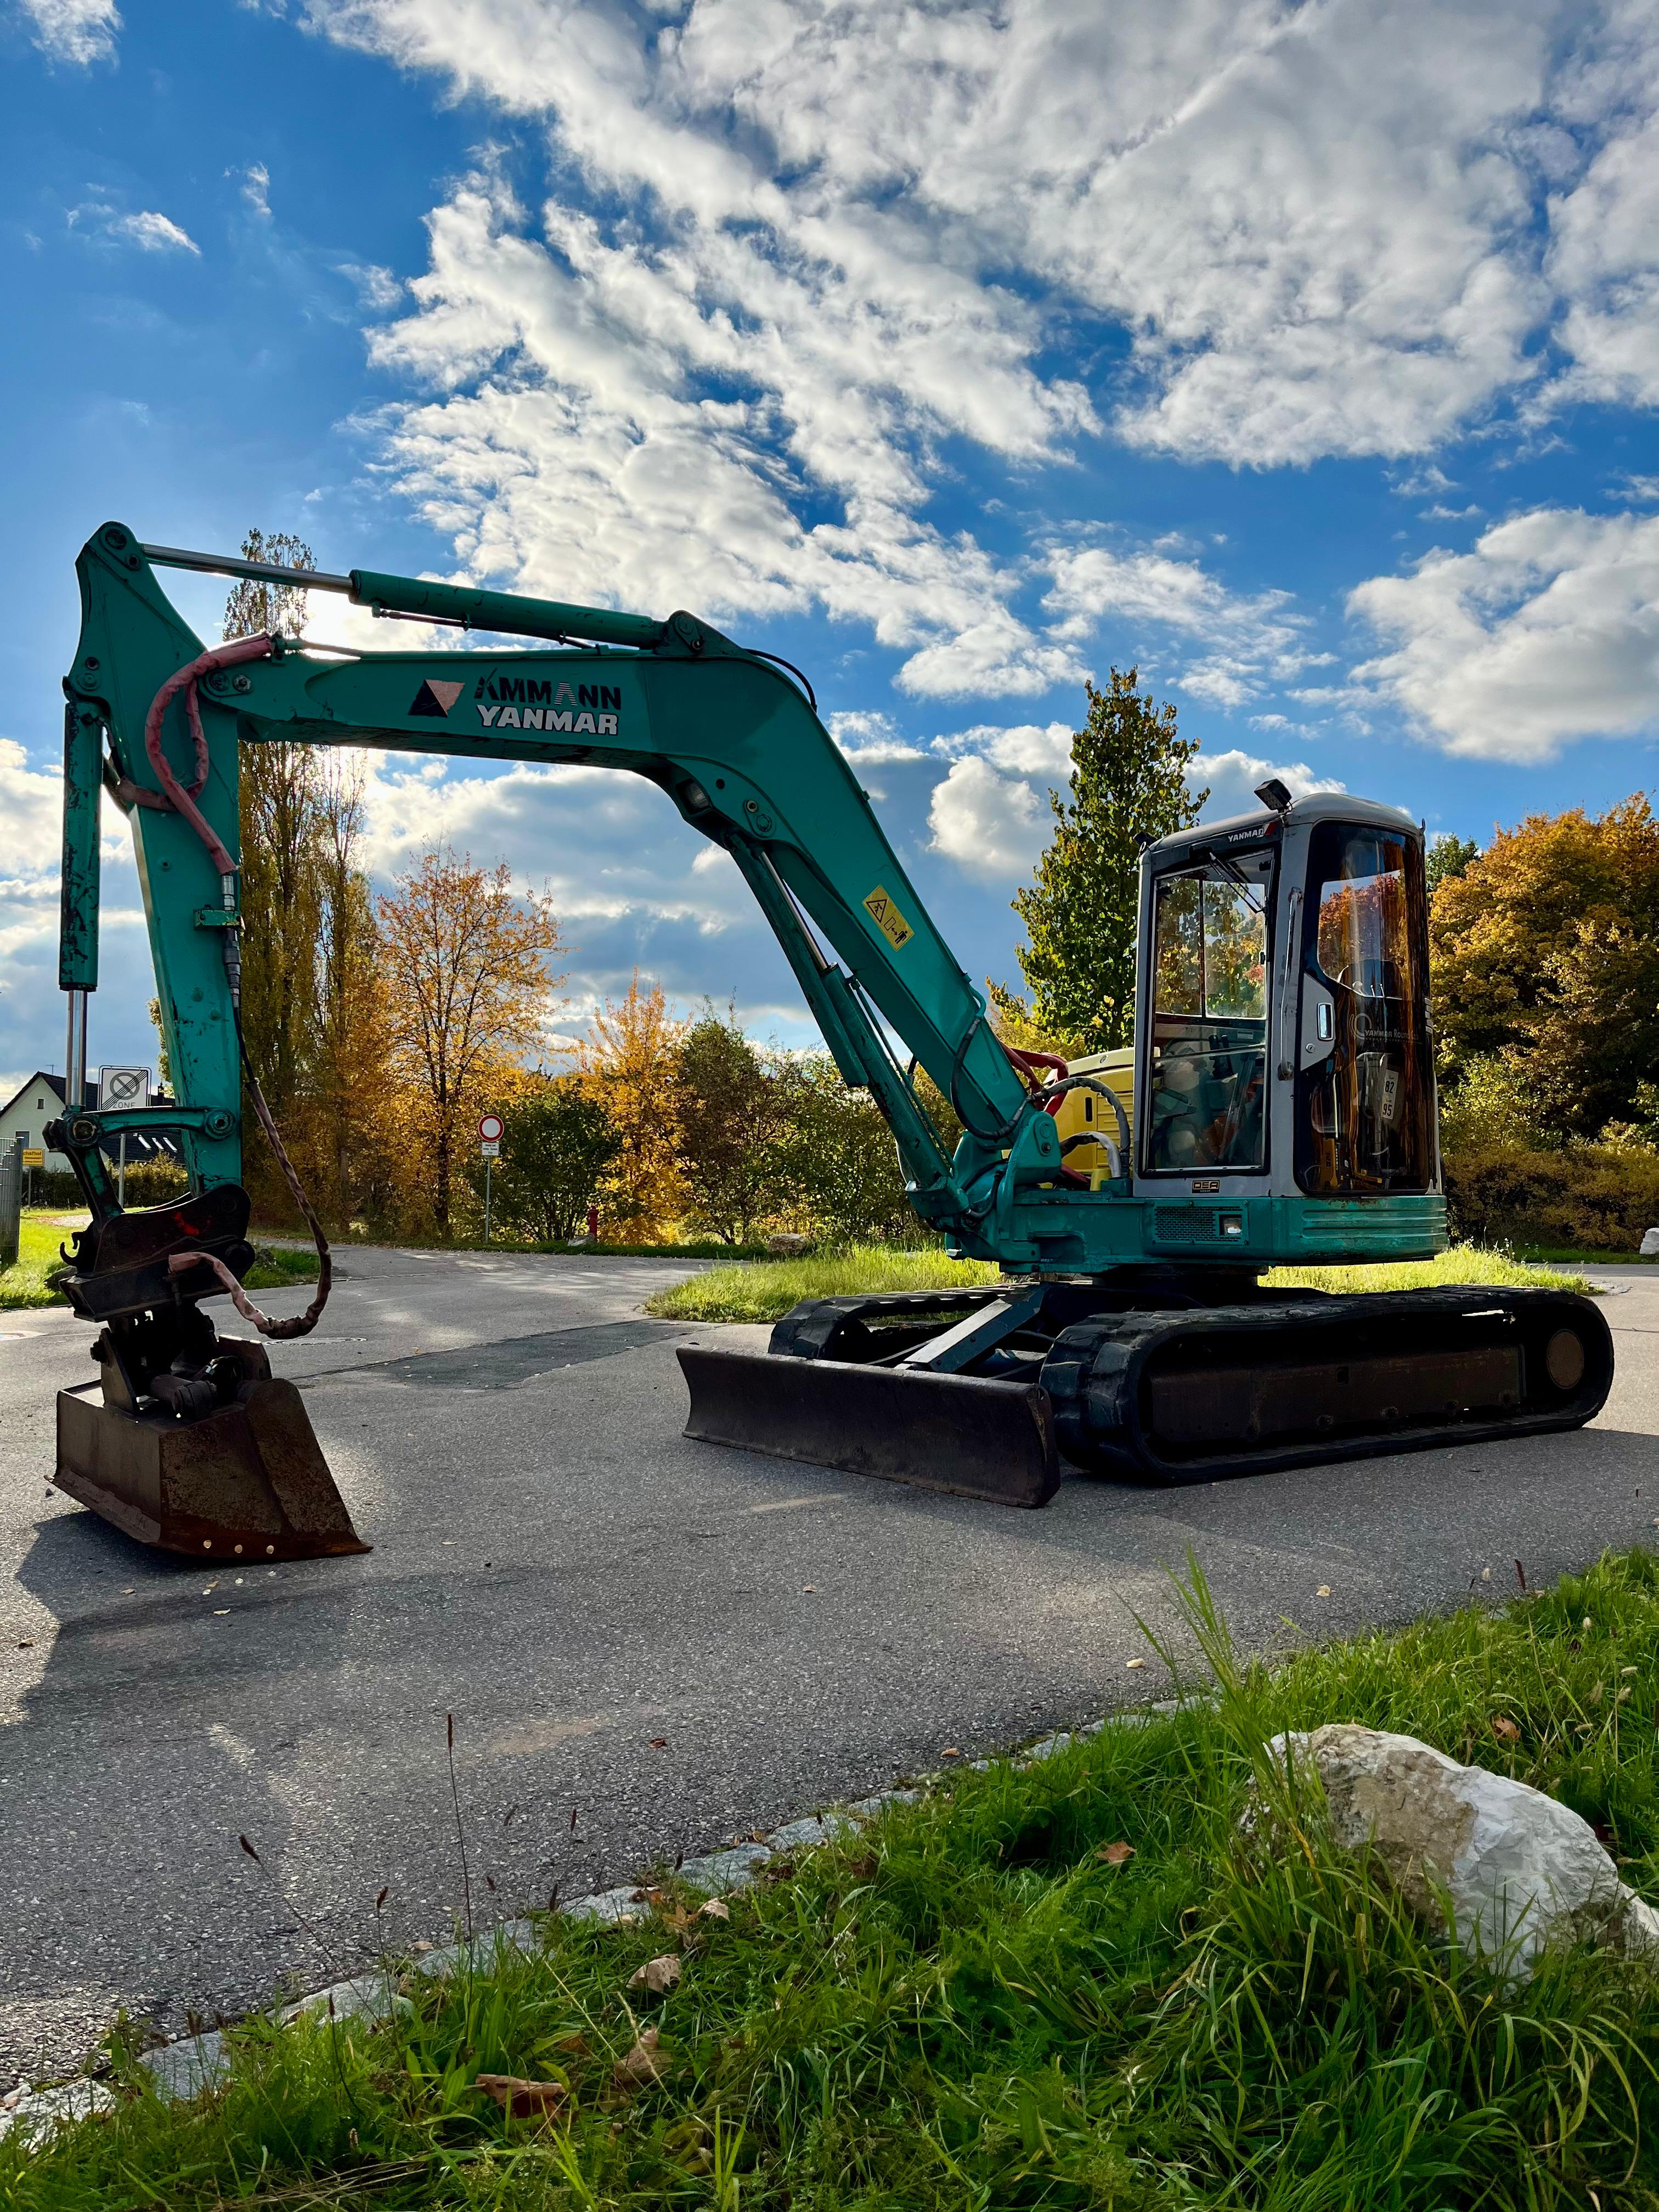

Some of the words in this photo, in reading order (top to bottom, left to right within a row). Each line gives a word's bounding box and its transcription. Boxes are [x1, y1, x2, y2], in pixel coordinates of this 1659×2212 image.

[475, 674, 621, 710] AMMANN
[476, 704, 618, 735] YANMAR
[1228, 828, 1264, 842] YANMAR
[1385, 1080, 1395, 1094] 82
[1383, 1103, 1392, 1116] 95
